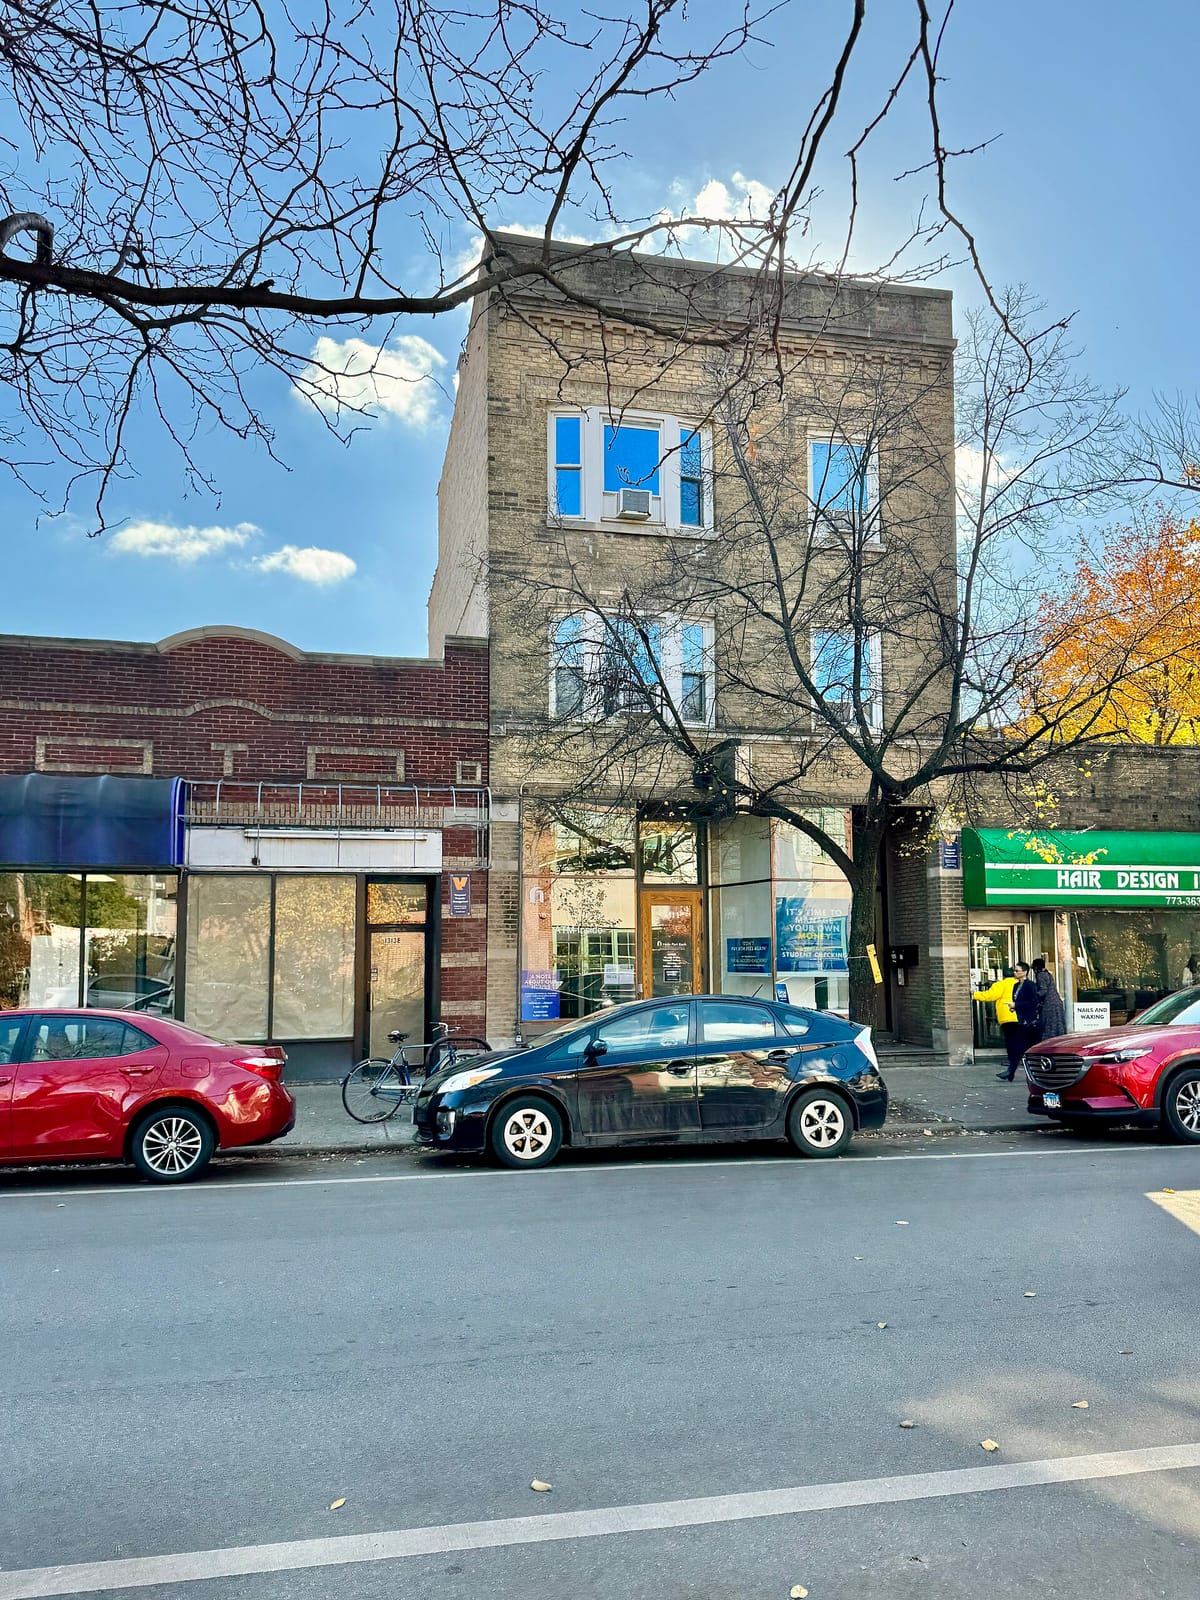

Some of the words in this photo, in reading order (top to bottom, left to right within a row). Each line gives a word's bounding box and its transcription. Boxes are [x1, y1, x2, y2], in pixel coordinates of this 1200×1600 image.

[1057, 870, 1101, 889] HAIR
[1117, 872, 1179, 889] DESIGN
[1193, 873, 1200, 889] I
[806, 908, 826, 916] TIME
[789, 924, 815, 932] YOUR
[817, 924, 840, 932] OWN
